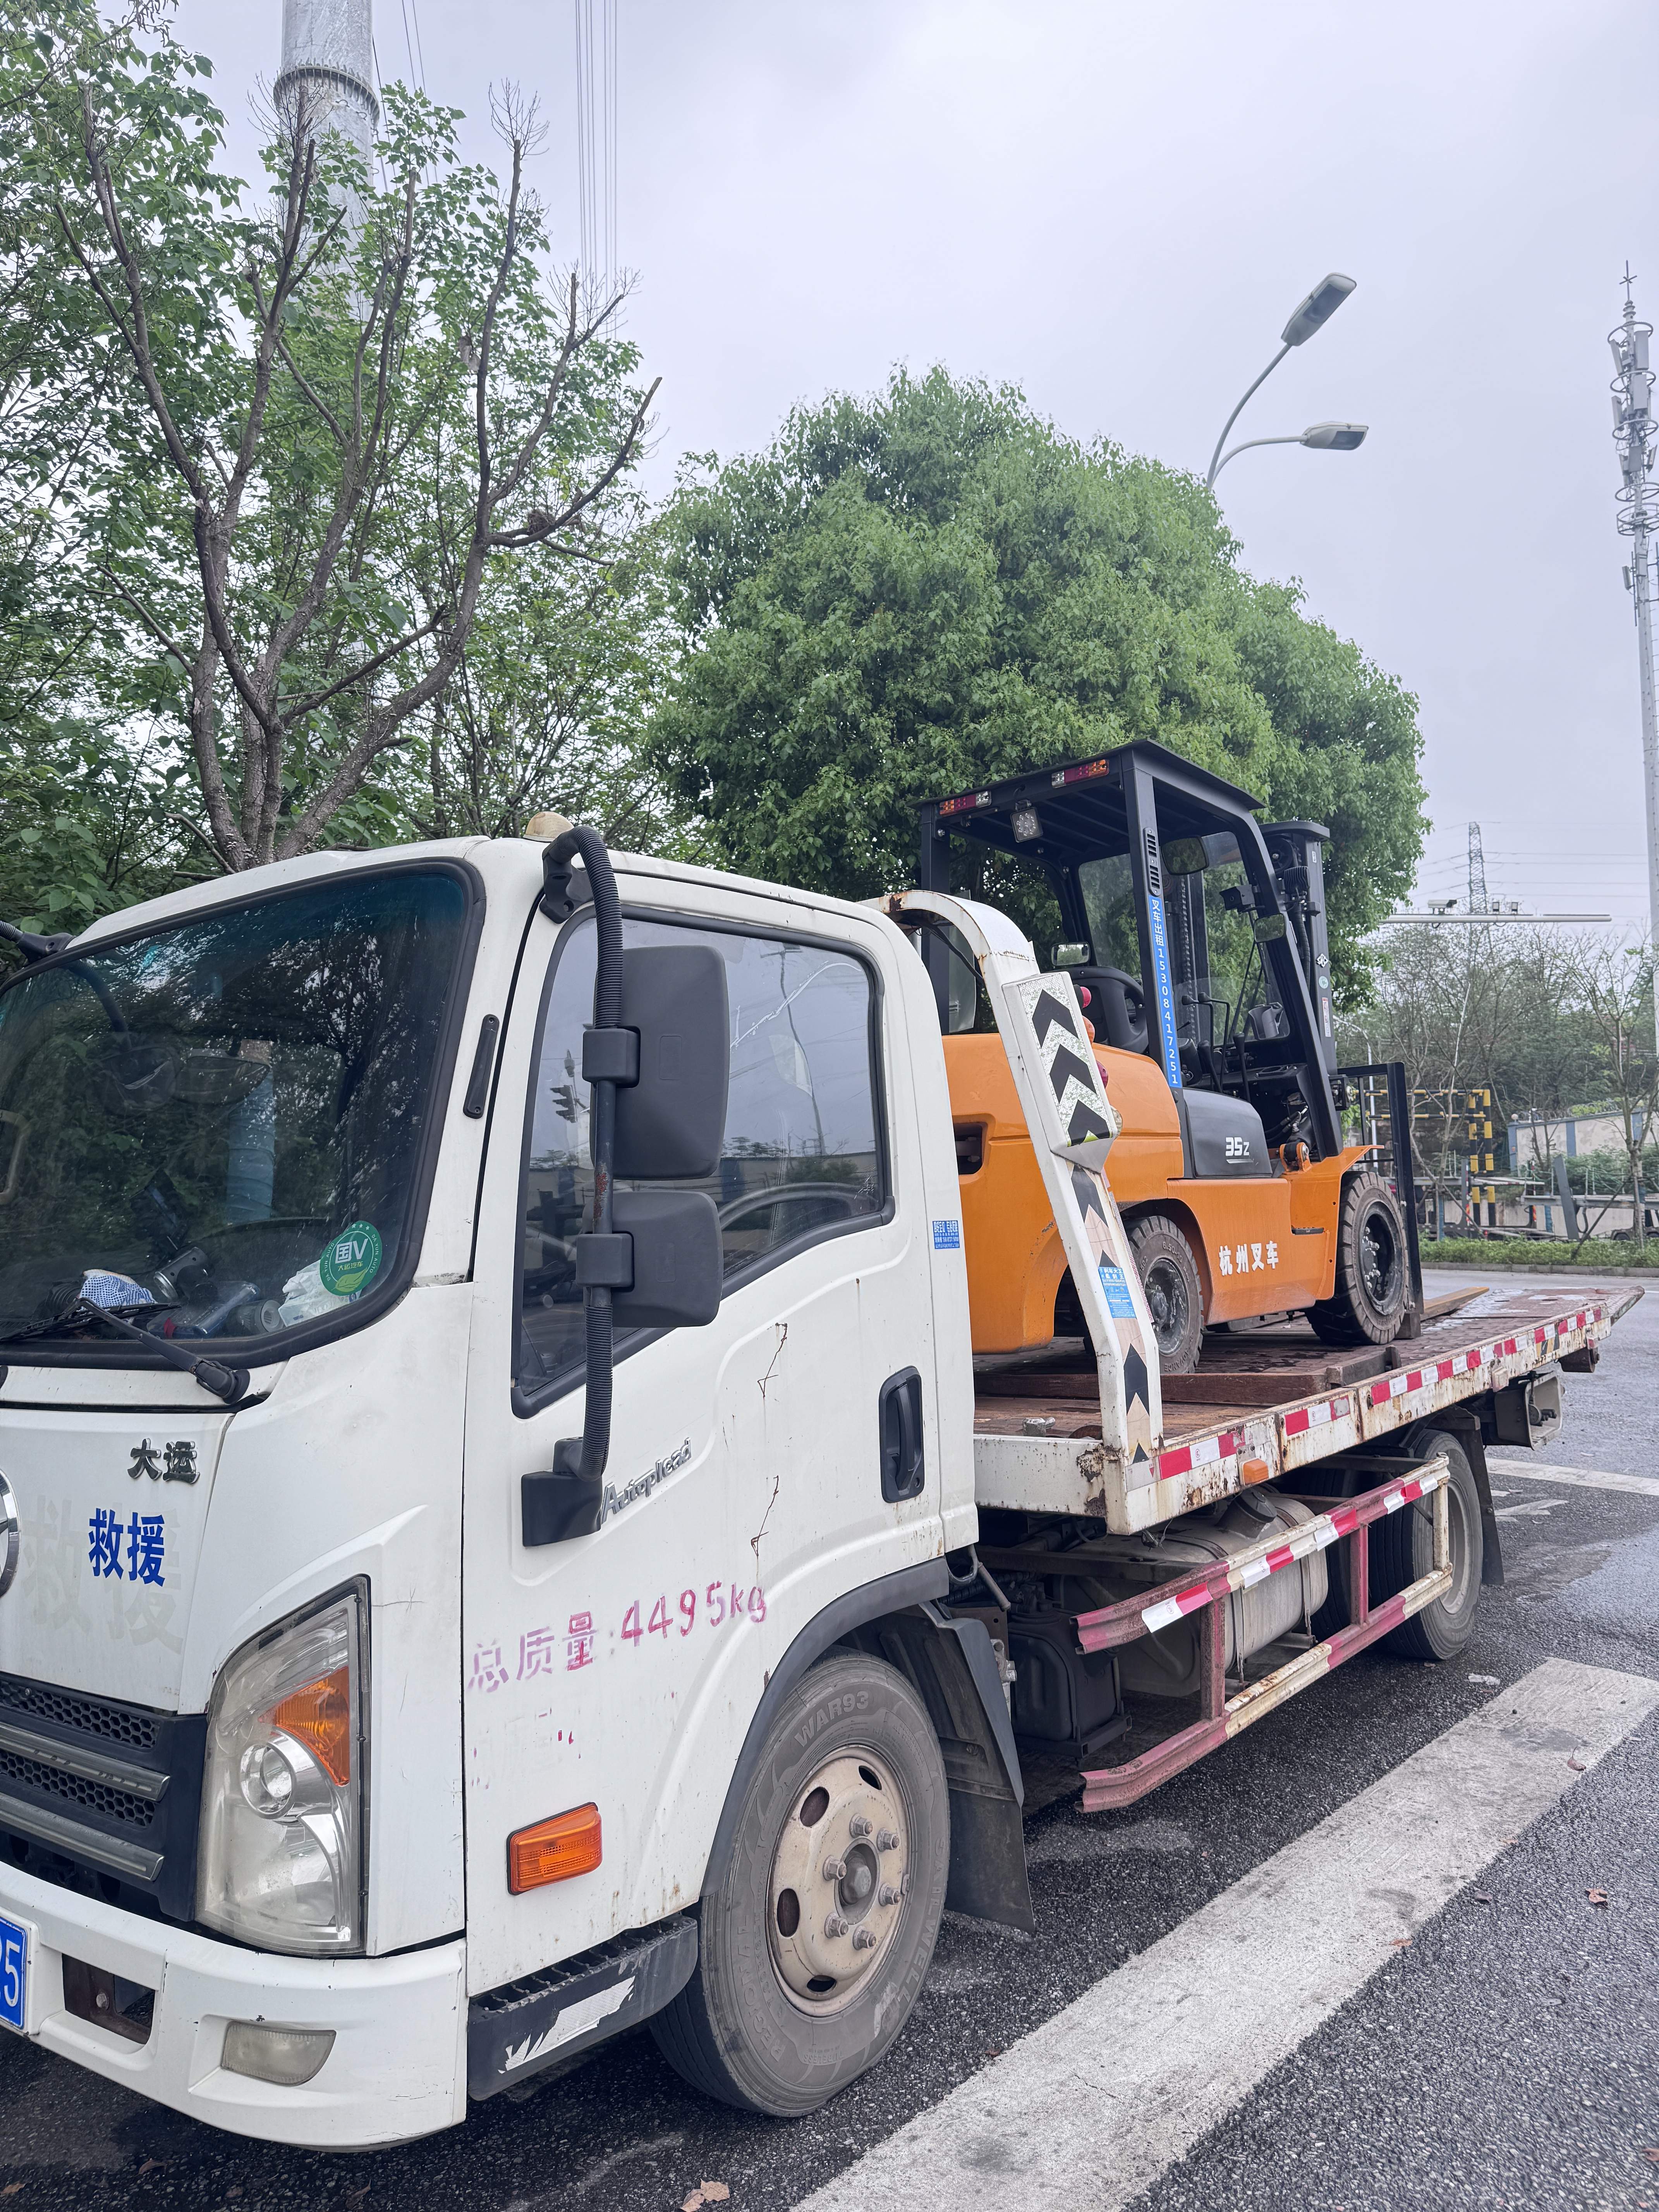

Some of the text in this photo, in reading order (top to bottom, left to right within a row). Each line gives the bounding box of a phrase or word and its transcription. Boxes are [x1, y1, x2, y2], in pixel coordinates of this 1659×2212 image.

[1151, 899, 1178, 1084] 叉车出租15308417251
[335, 1238, 369, 1264] 国V
[1219, 1240, 1279, 1276] 杭州叉车
[127, 1438, 200, 1484] 大运
[88, 1508, 165, 1587] 救援
[794, 1691, 869, 1747] WAR93
[897, 1836, 946, 2003] SAILWELL
[0, 1935, 20, 2008] 5
[737, 1915, 786, 2063] REGIONAL
